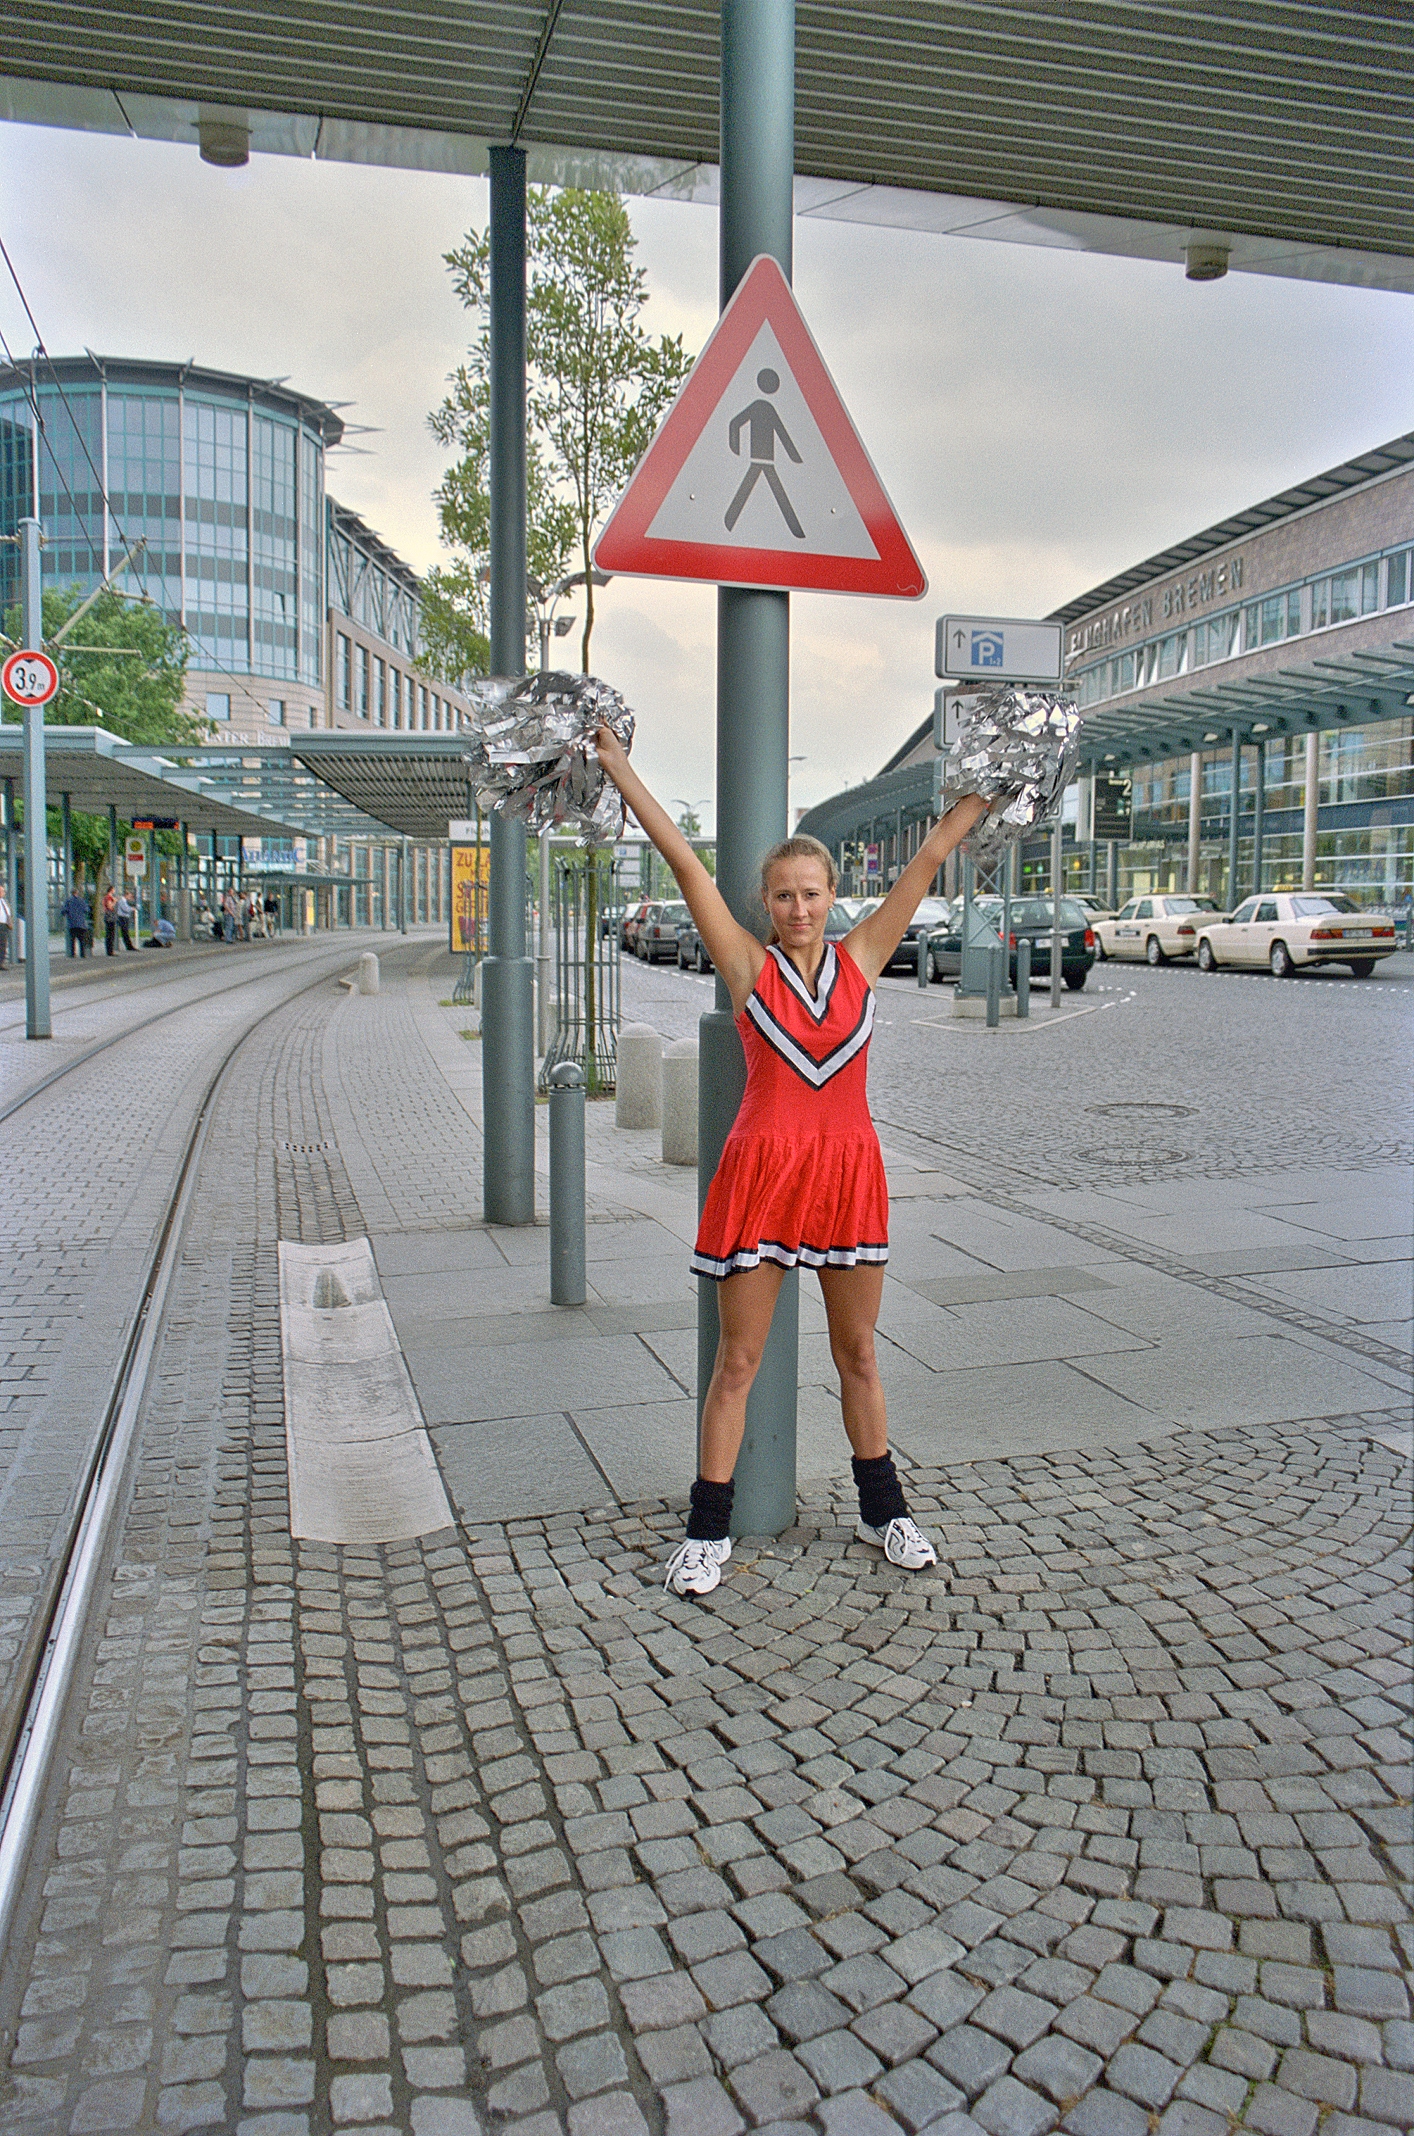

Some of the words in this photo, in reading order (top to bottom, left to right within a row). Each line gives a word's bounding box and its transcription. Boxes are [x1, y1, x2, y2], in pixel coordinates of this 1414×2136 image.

[1070, 599, 1153, 652] FLUGHAFEN
[1162, 556, 1243, 618] BREMEN
[979, 641, 995, 665] P
[1122, 778, 1132, 797] 2
[242, 846, 305, 863] ATLANTIC
[456, 852, 473, 868] ZU
